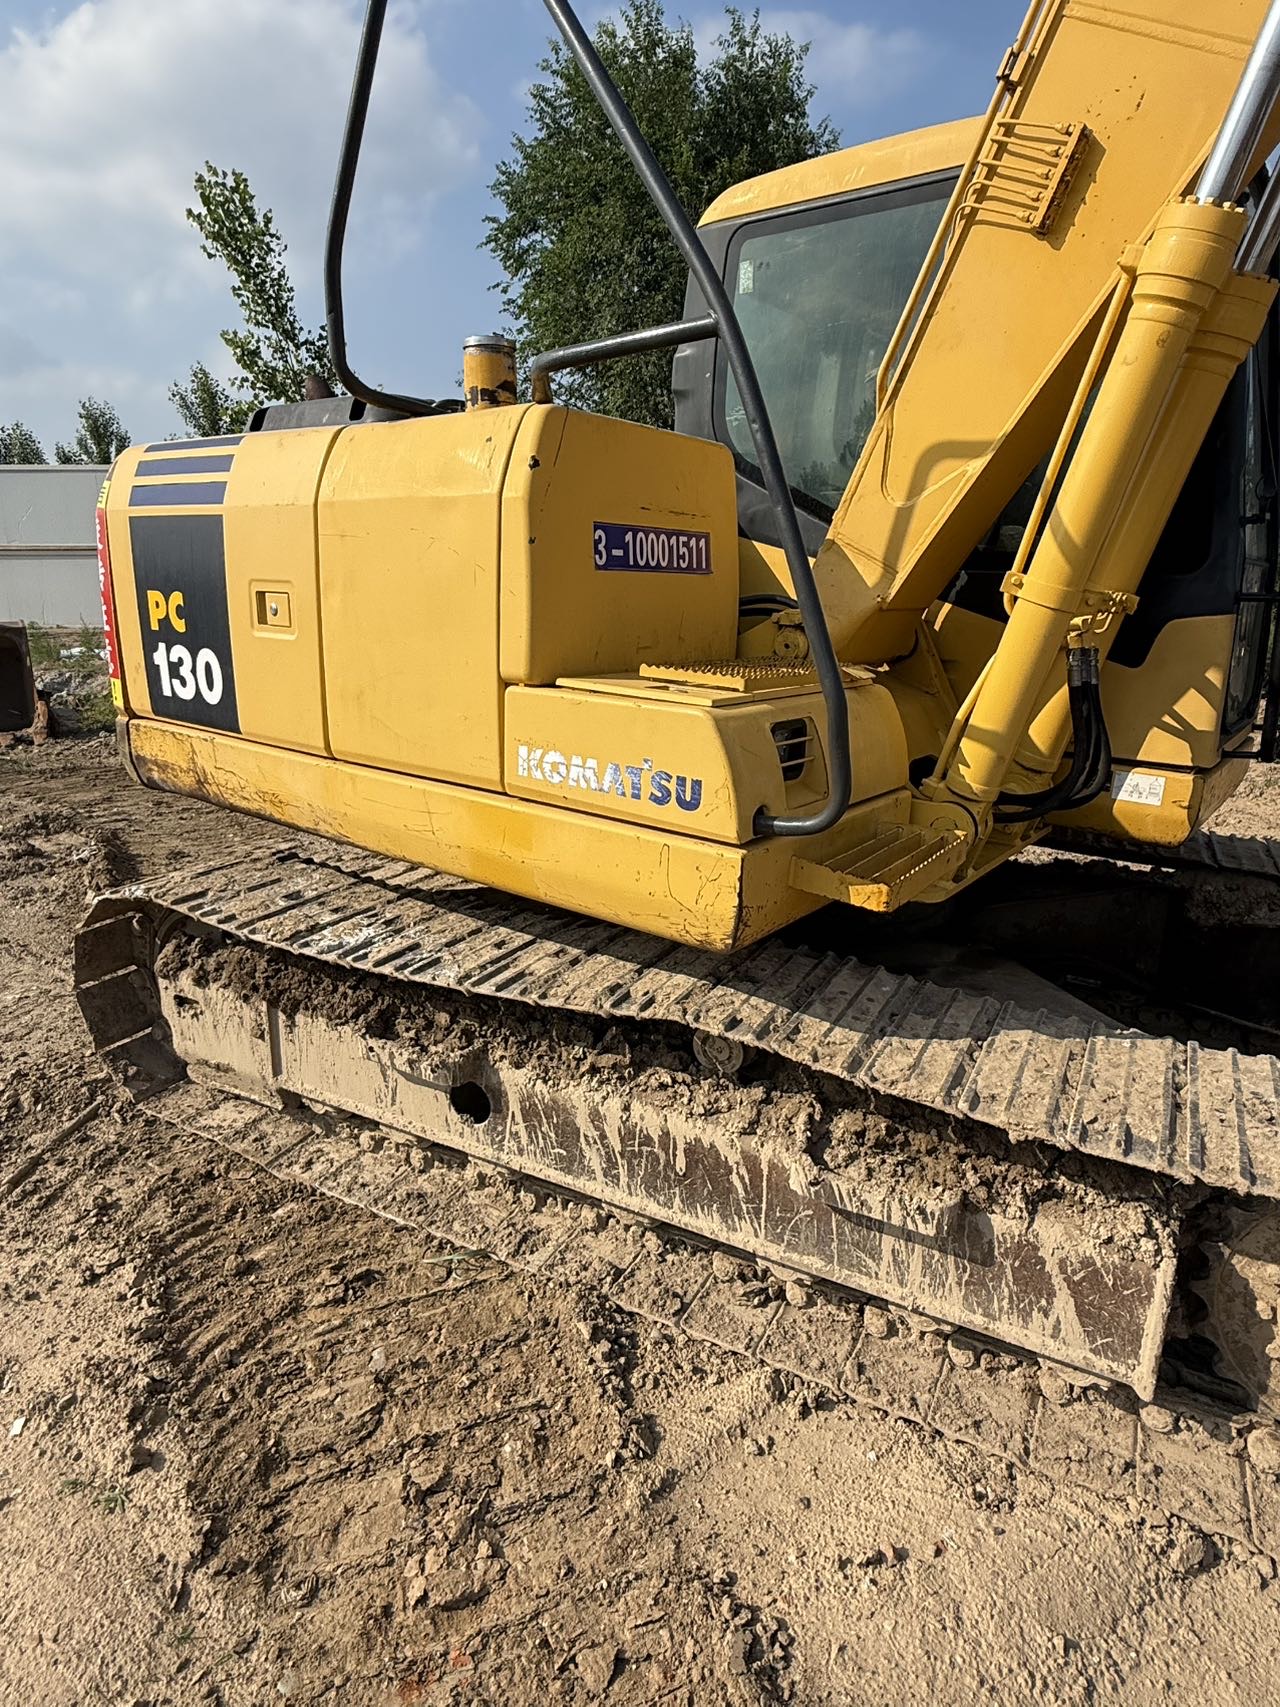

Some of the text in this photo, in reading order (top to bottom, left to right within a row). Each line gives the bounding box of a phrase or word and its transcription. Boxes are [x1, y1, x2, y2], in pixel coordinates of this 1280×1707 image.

[147, 590, 186, 633] PC
[153, 642, 223, 705] 130
[517, 744, 702, 812] KOMATSU
